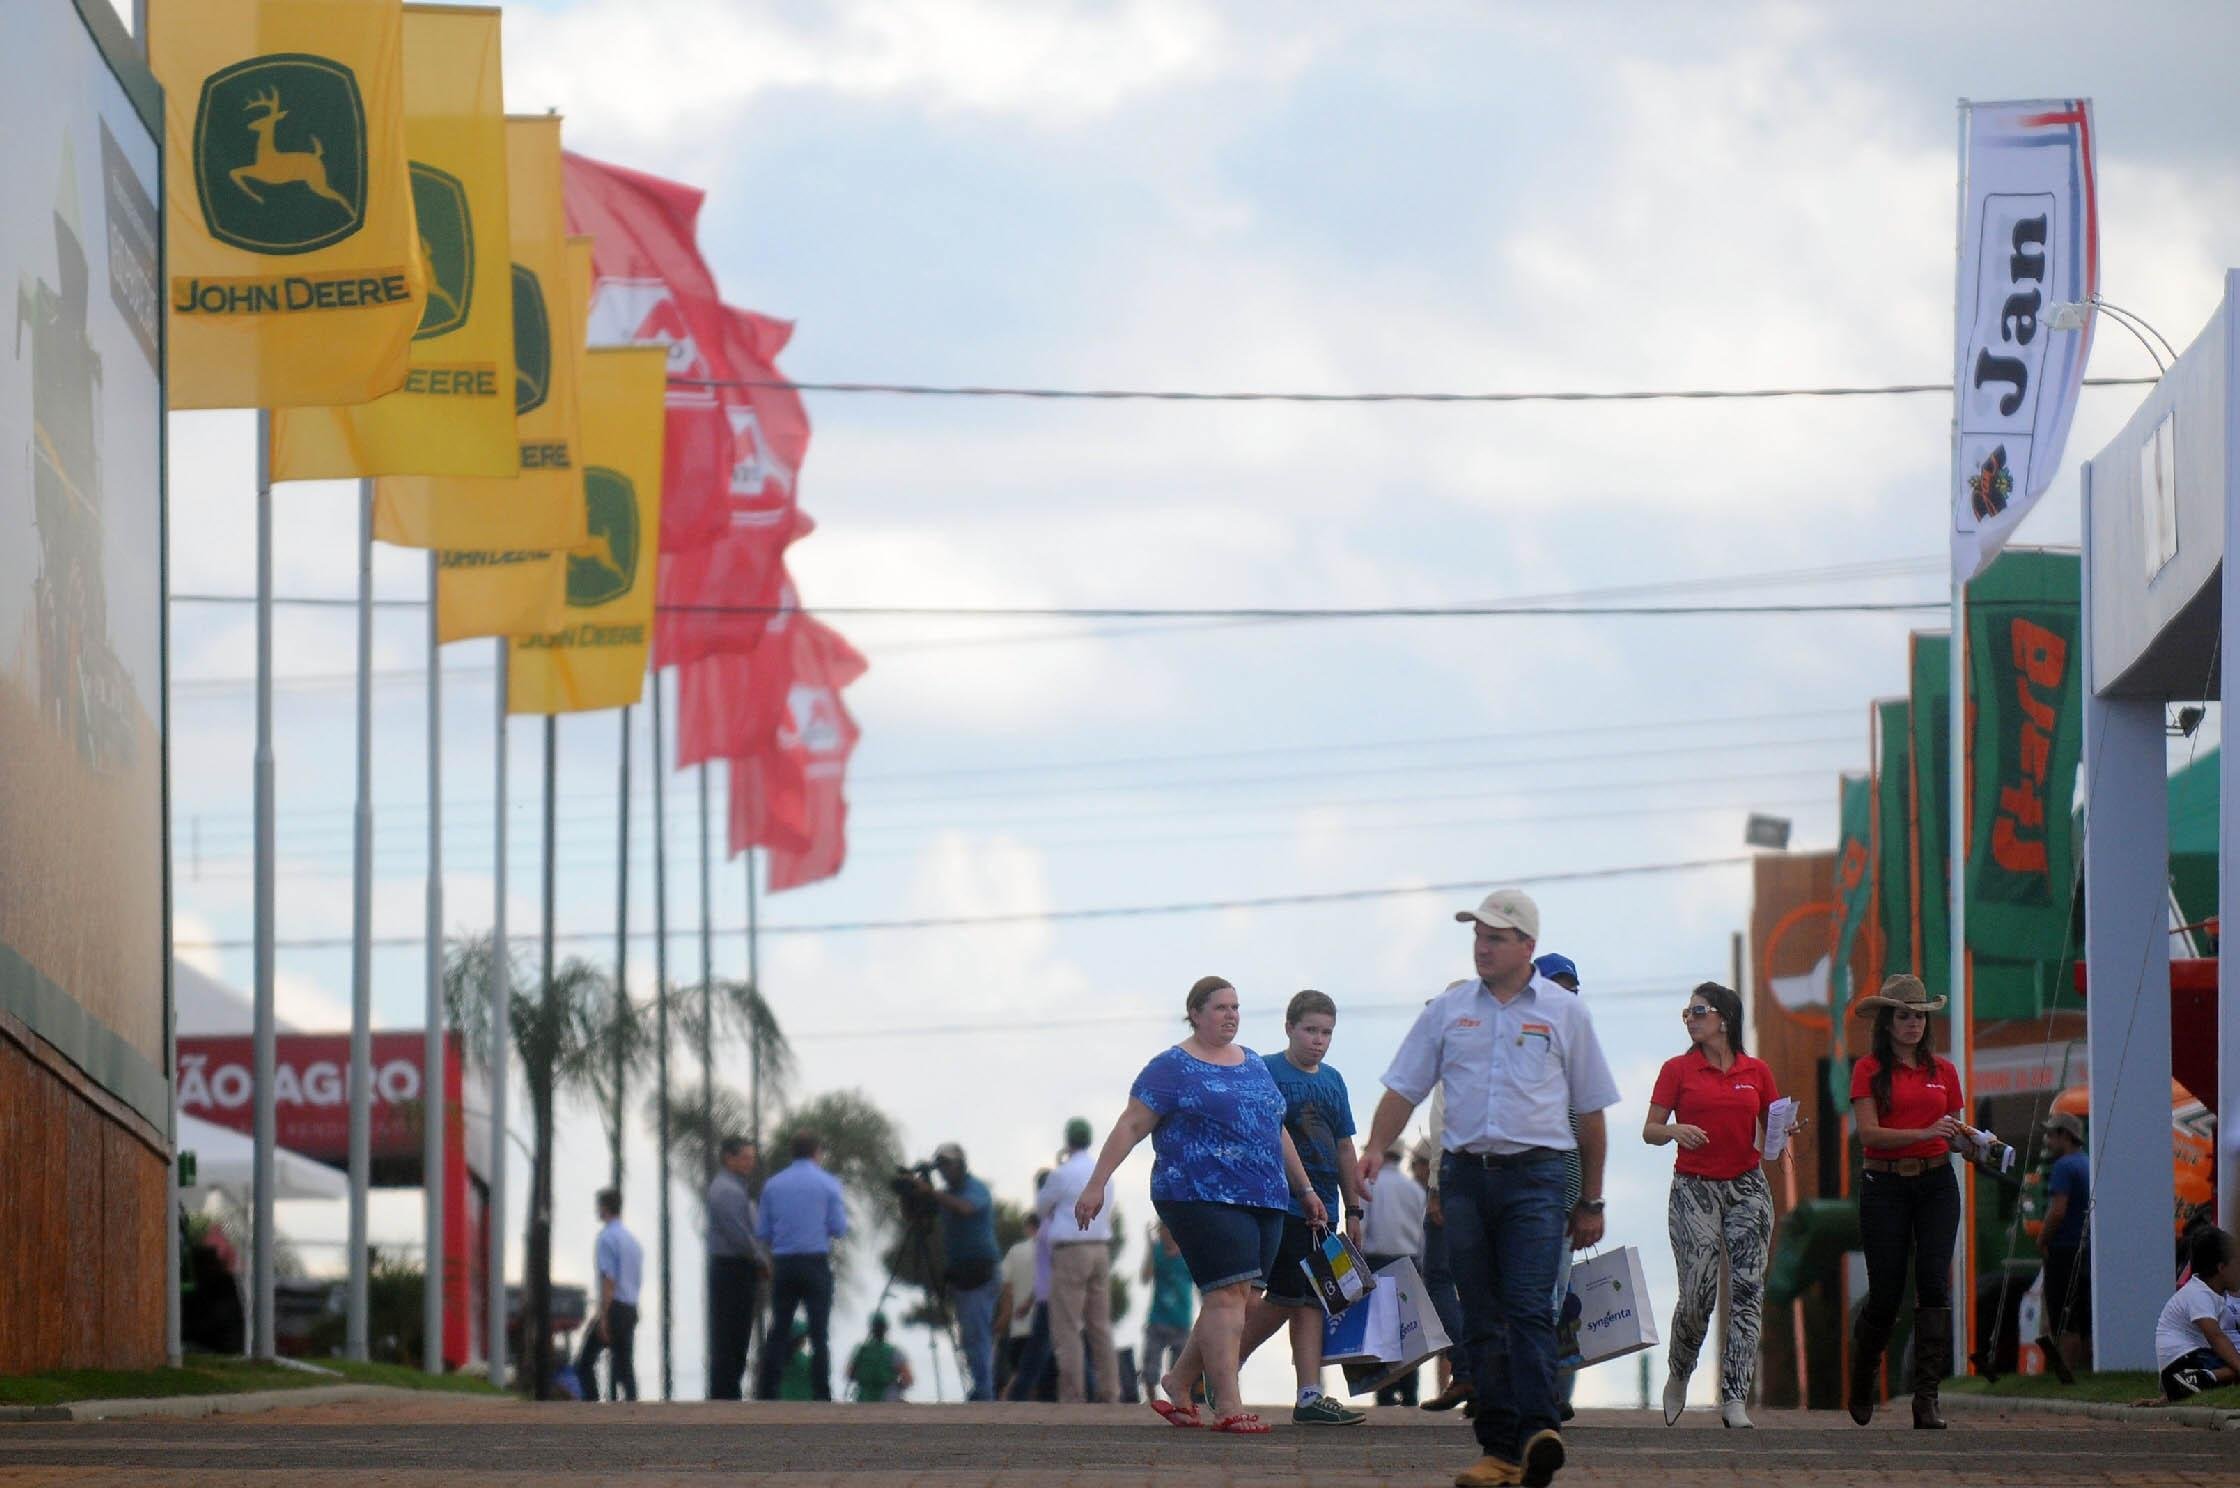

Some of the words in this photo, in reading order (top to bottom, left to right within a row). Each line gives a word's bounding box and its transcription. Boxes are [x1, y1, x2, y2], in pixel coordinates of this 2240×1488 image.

[175, 279, 279, 313] JOHN
[284, 274, 411, 311] DEERE
[1973, 212, 2048, 417] Jan
[404, 368, 497, 396] EERE
[519, 443, 571, 470] ERE
[179, 1053, 251, 1109] ÃO
[1587, 1308, 1632, 1333] syngenta
